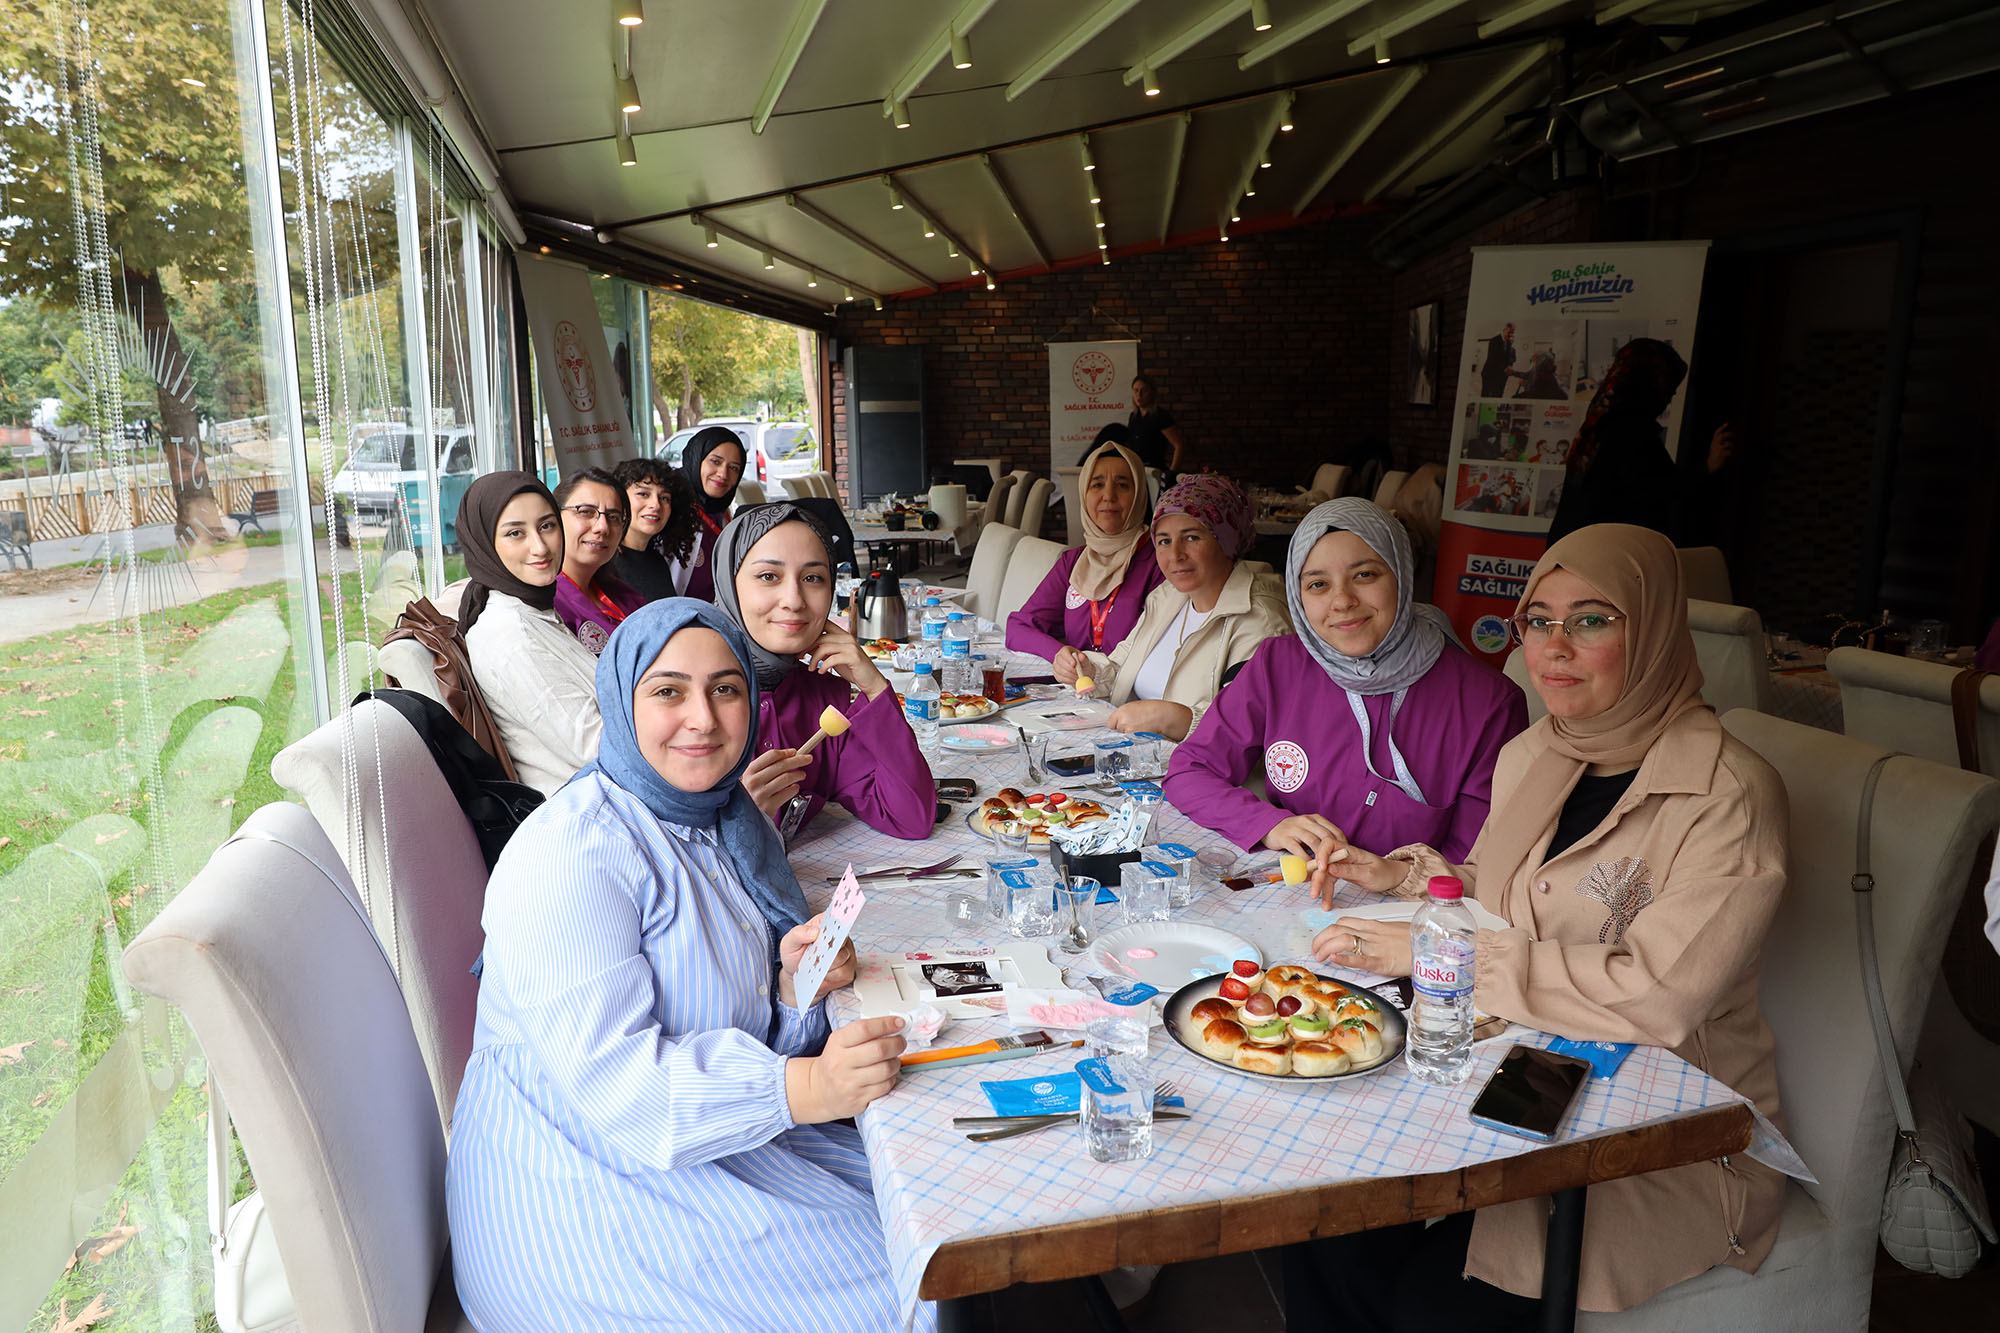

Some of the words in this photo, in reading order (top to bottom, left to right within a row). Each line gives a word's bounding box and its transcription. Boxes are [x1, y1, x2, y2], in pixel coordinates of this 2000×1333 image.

[1551, 269, 1571, 282] Bu
[1573, 262, 1615, 281] Şehir
[1526, 274, 1634, 306] Hepimizin
[1471, 558, 1535, 577] SAĞLIK
[1460, 577, 1523, 597] SAĞLIK
